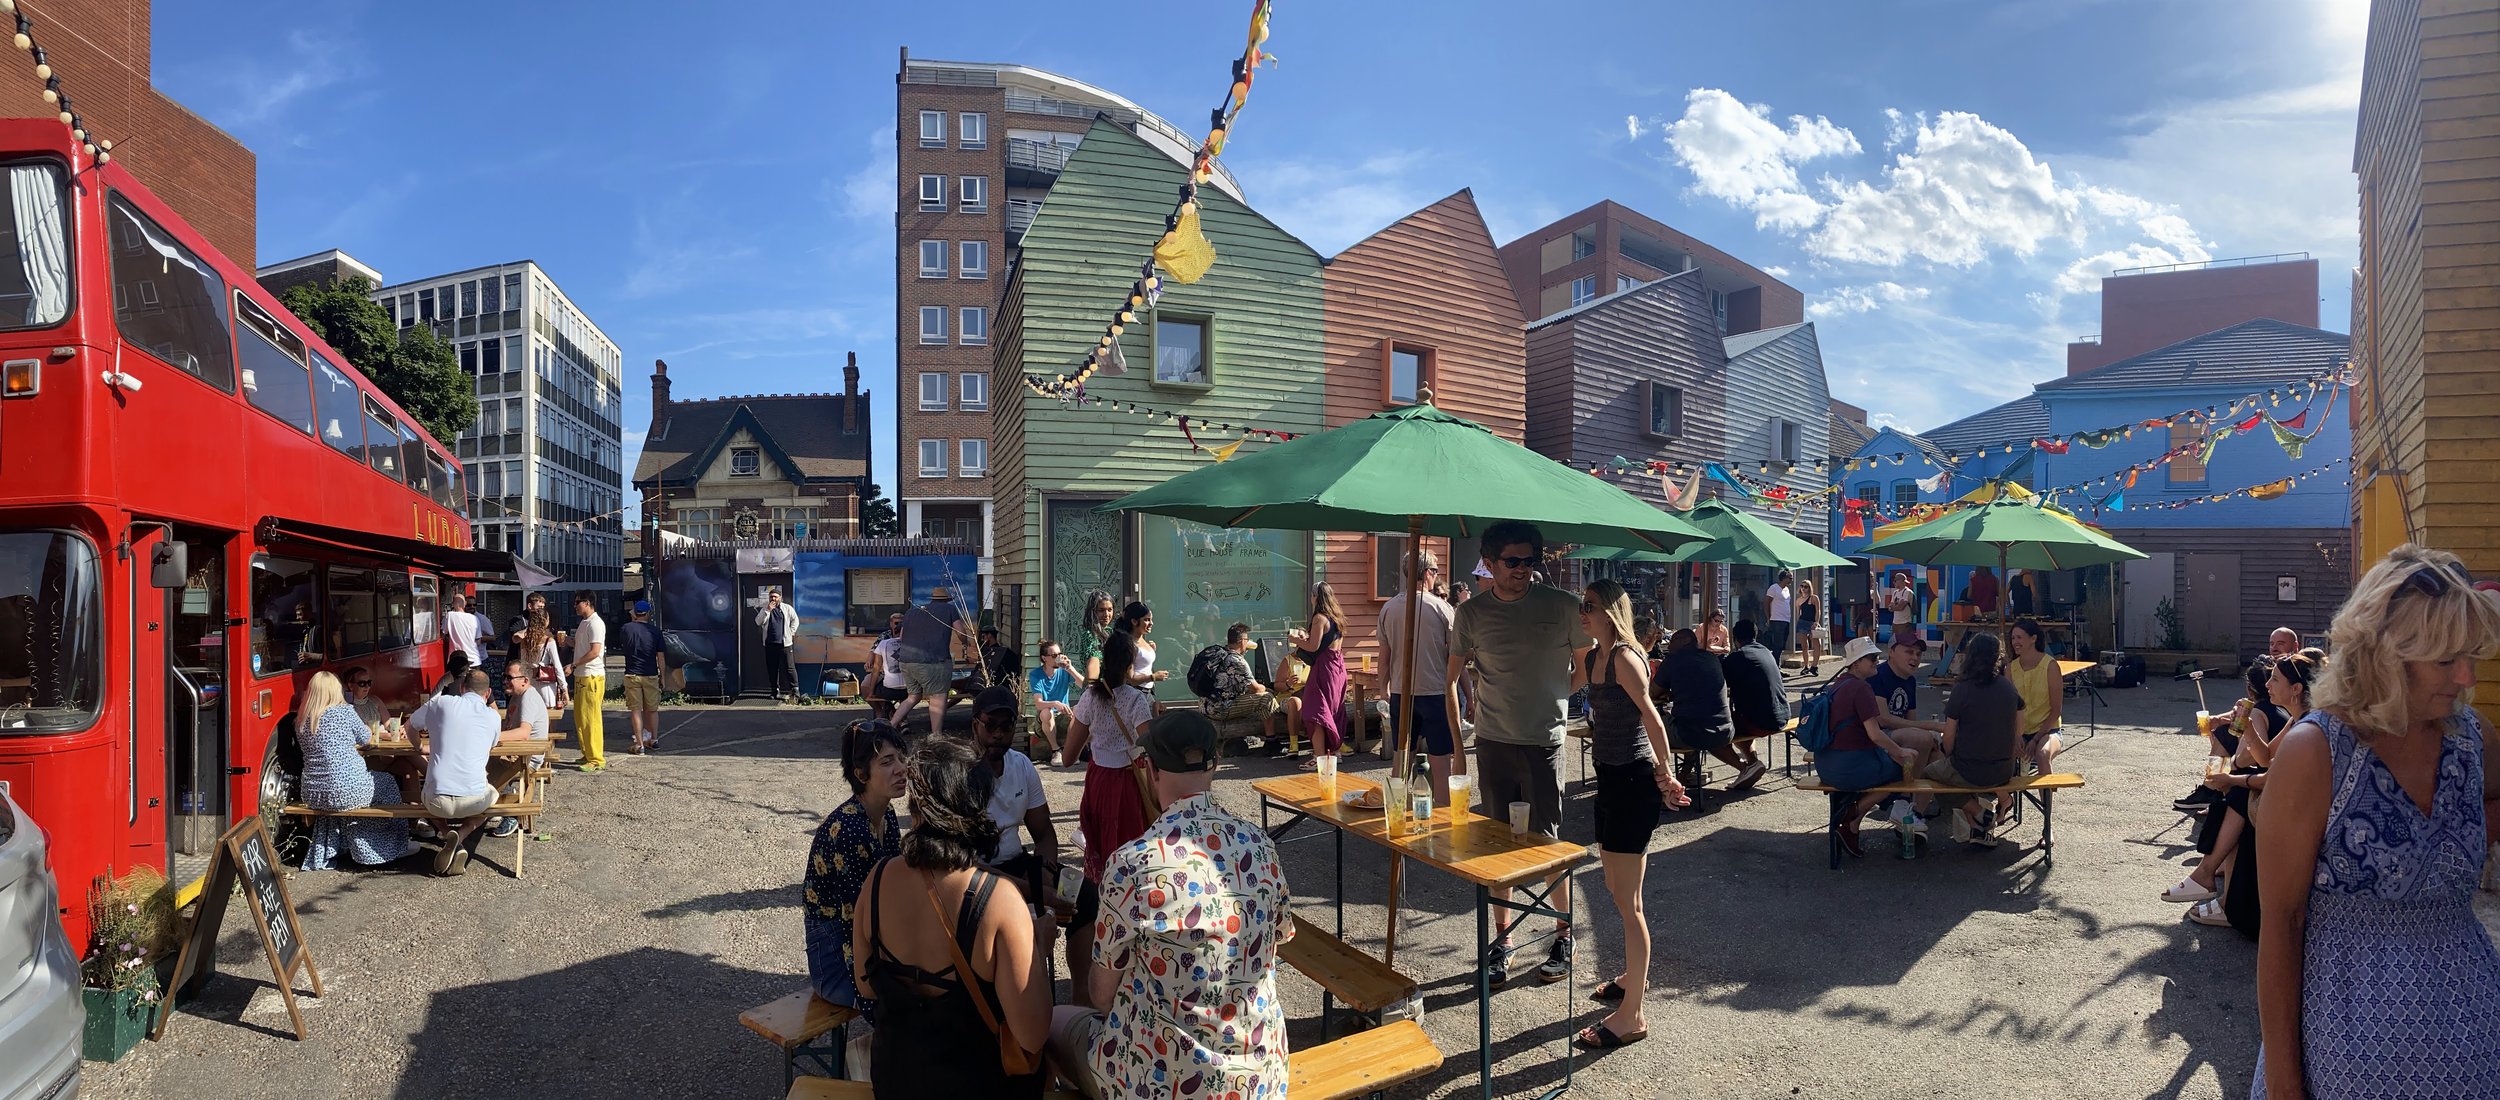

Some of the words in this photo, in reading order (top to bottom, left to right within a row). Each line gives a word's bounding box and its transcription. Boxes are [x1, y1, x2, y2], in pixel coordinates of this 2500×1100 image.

[1187, 549, 1205, 557] BLUE
[1209, 549, 1233, 557] HOUSE
[1240, 549, 1267, 557] FRAMER
[242, 838, 267, 882] BAR
[269, 908, 291, 954] OPEN
